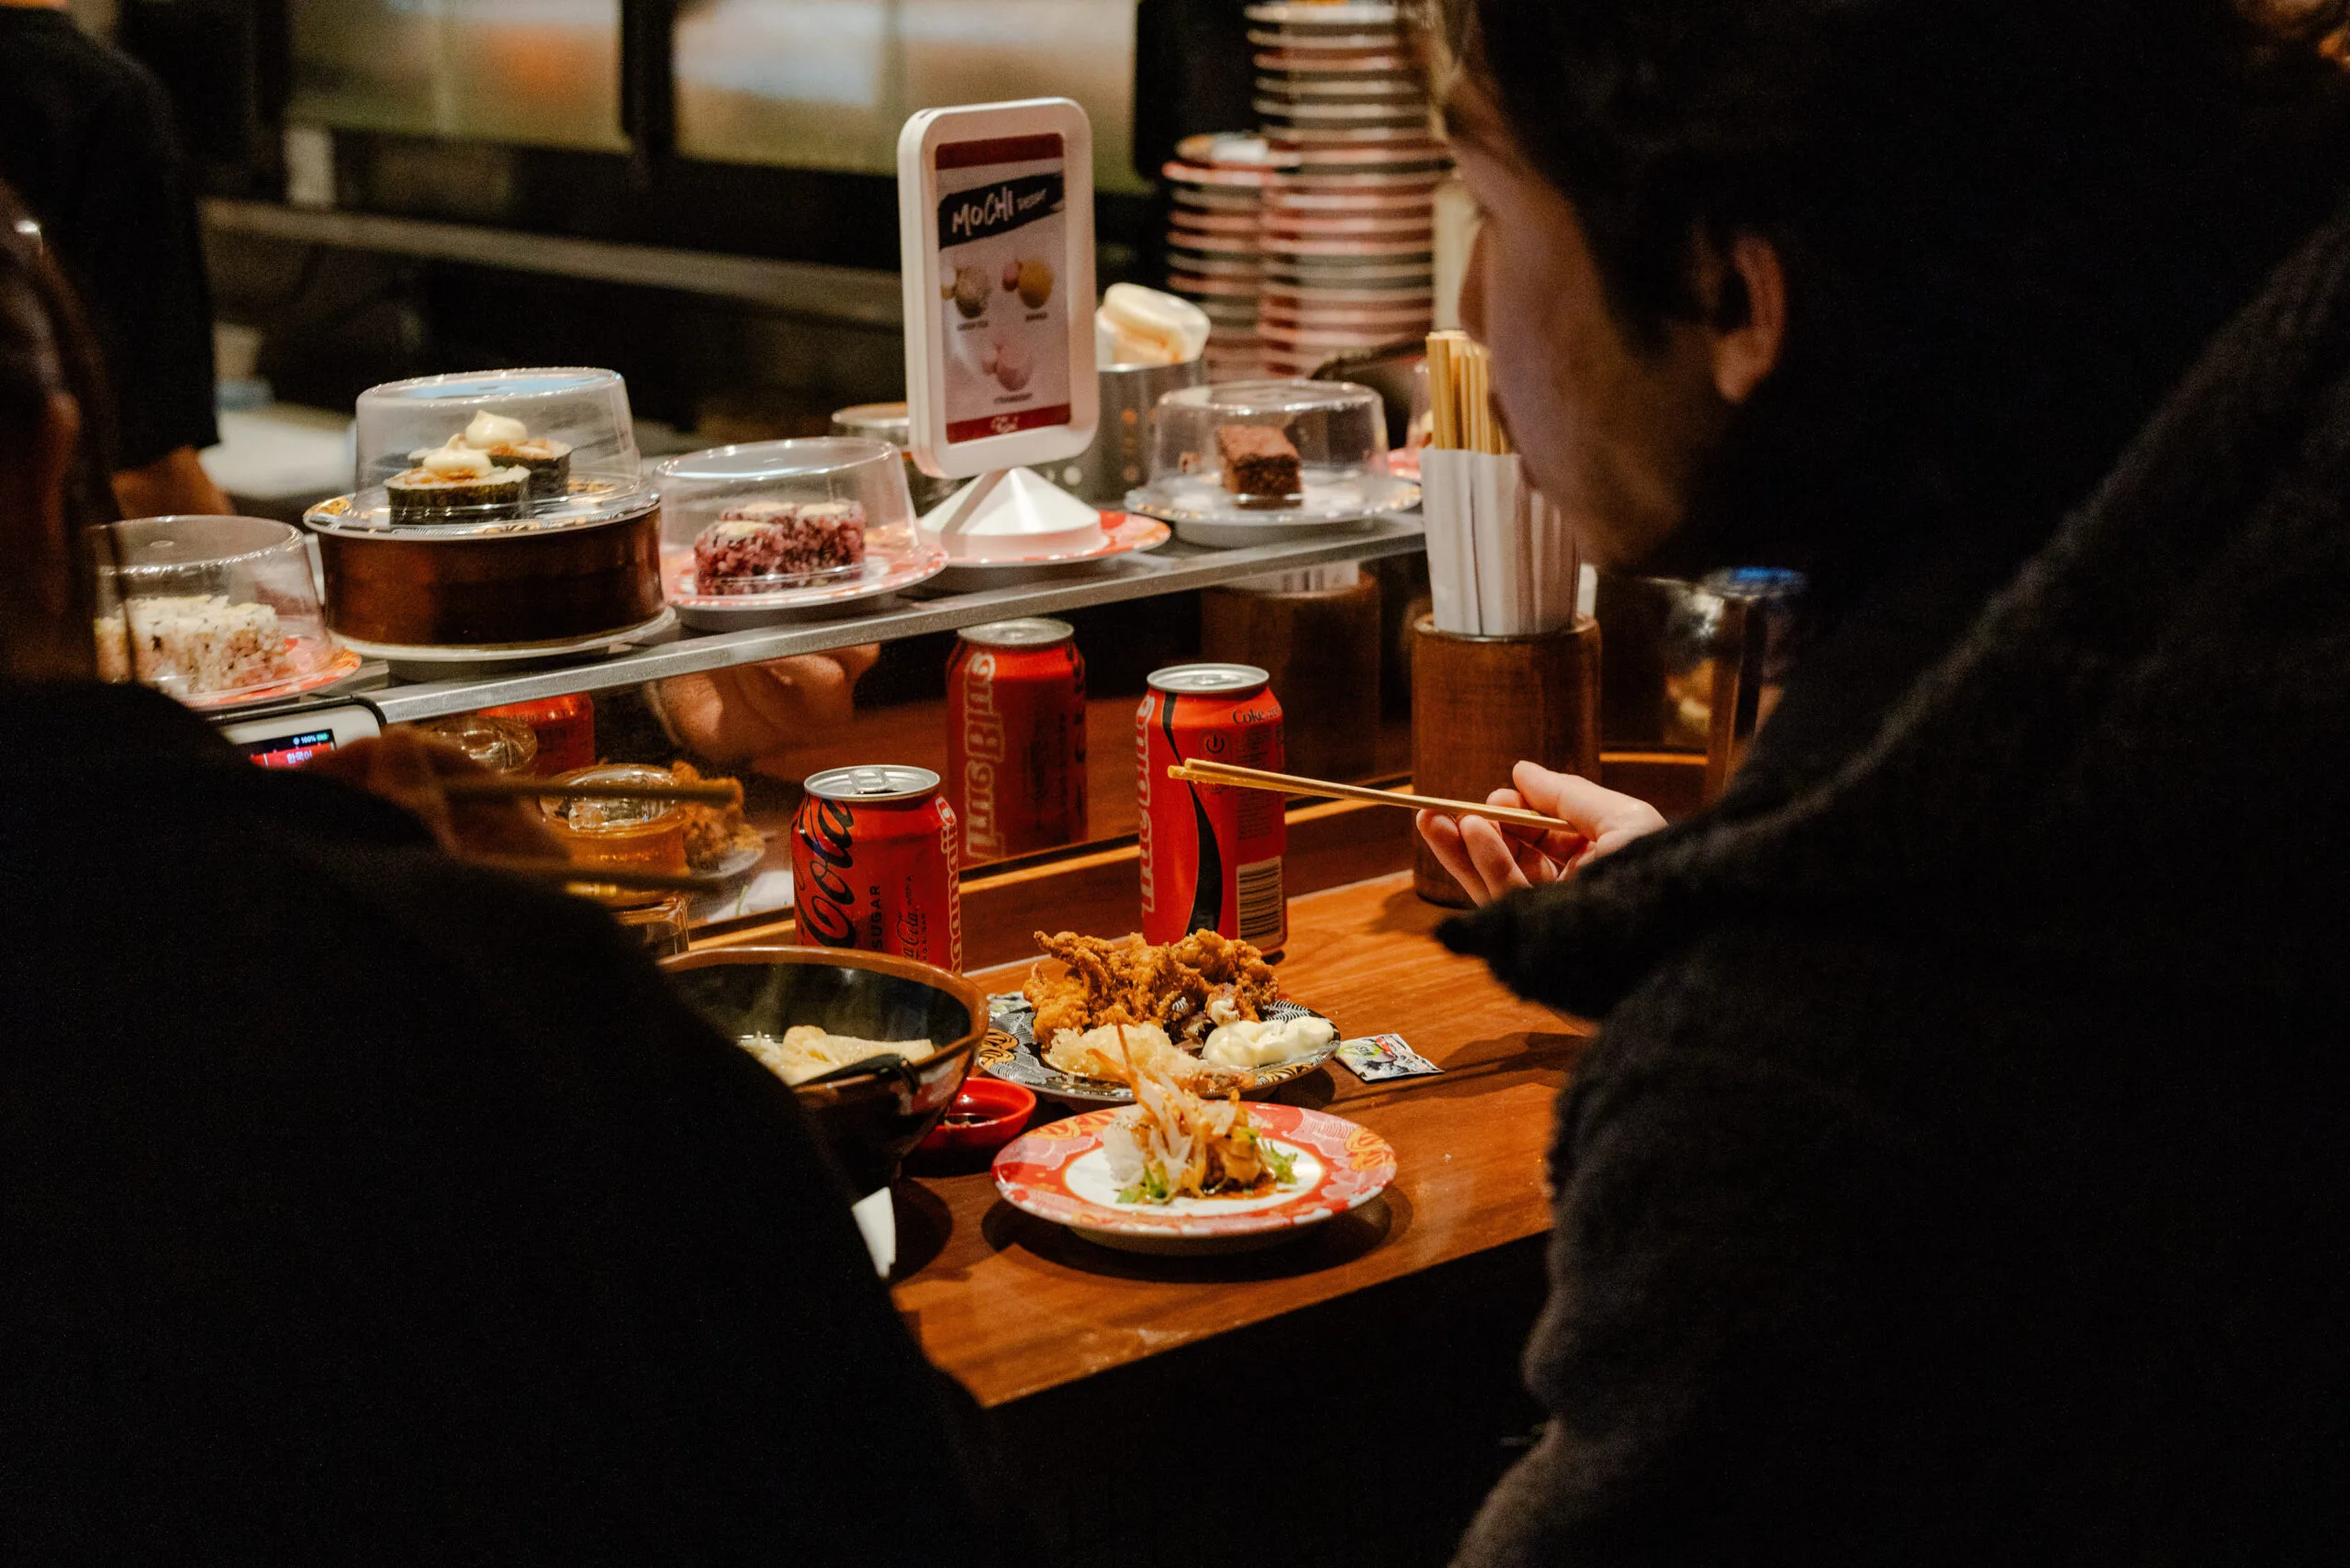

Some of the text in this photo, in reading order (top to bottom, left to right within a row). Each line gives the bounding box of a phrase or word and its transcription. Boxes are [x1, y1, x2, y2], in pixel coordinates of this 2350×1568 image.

[951, 186, 1014, 236] MOCHI
[1233, 708, 1263, 724] Coke
[792, 795, 856, 949] Cola
[869, 885, 883, 949] SUGAR
